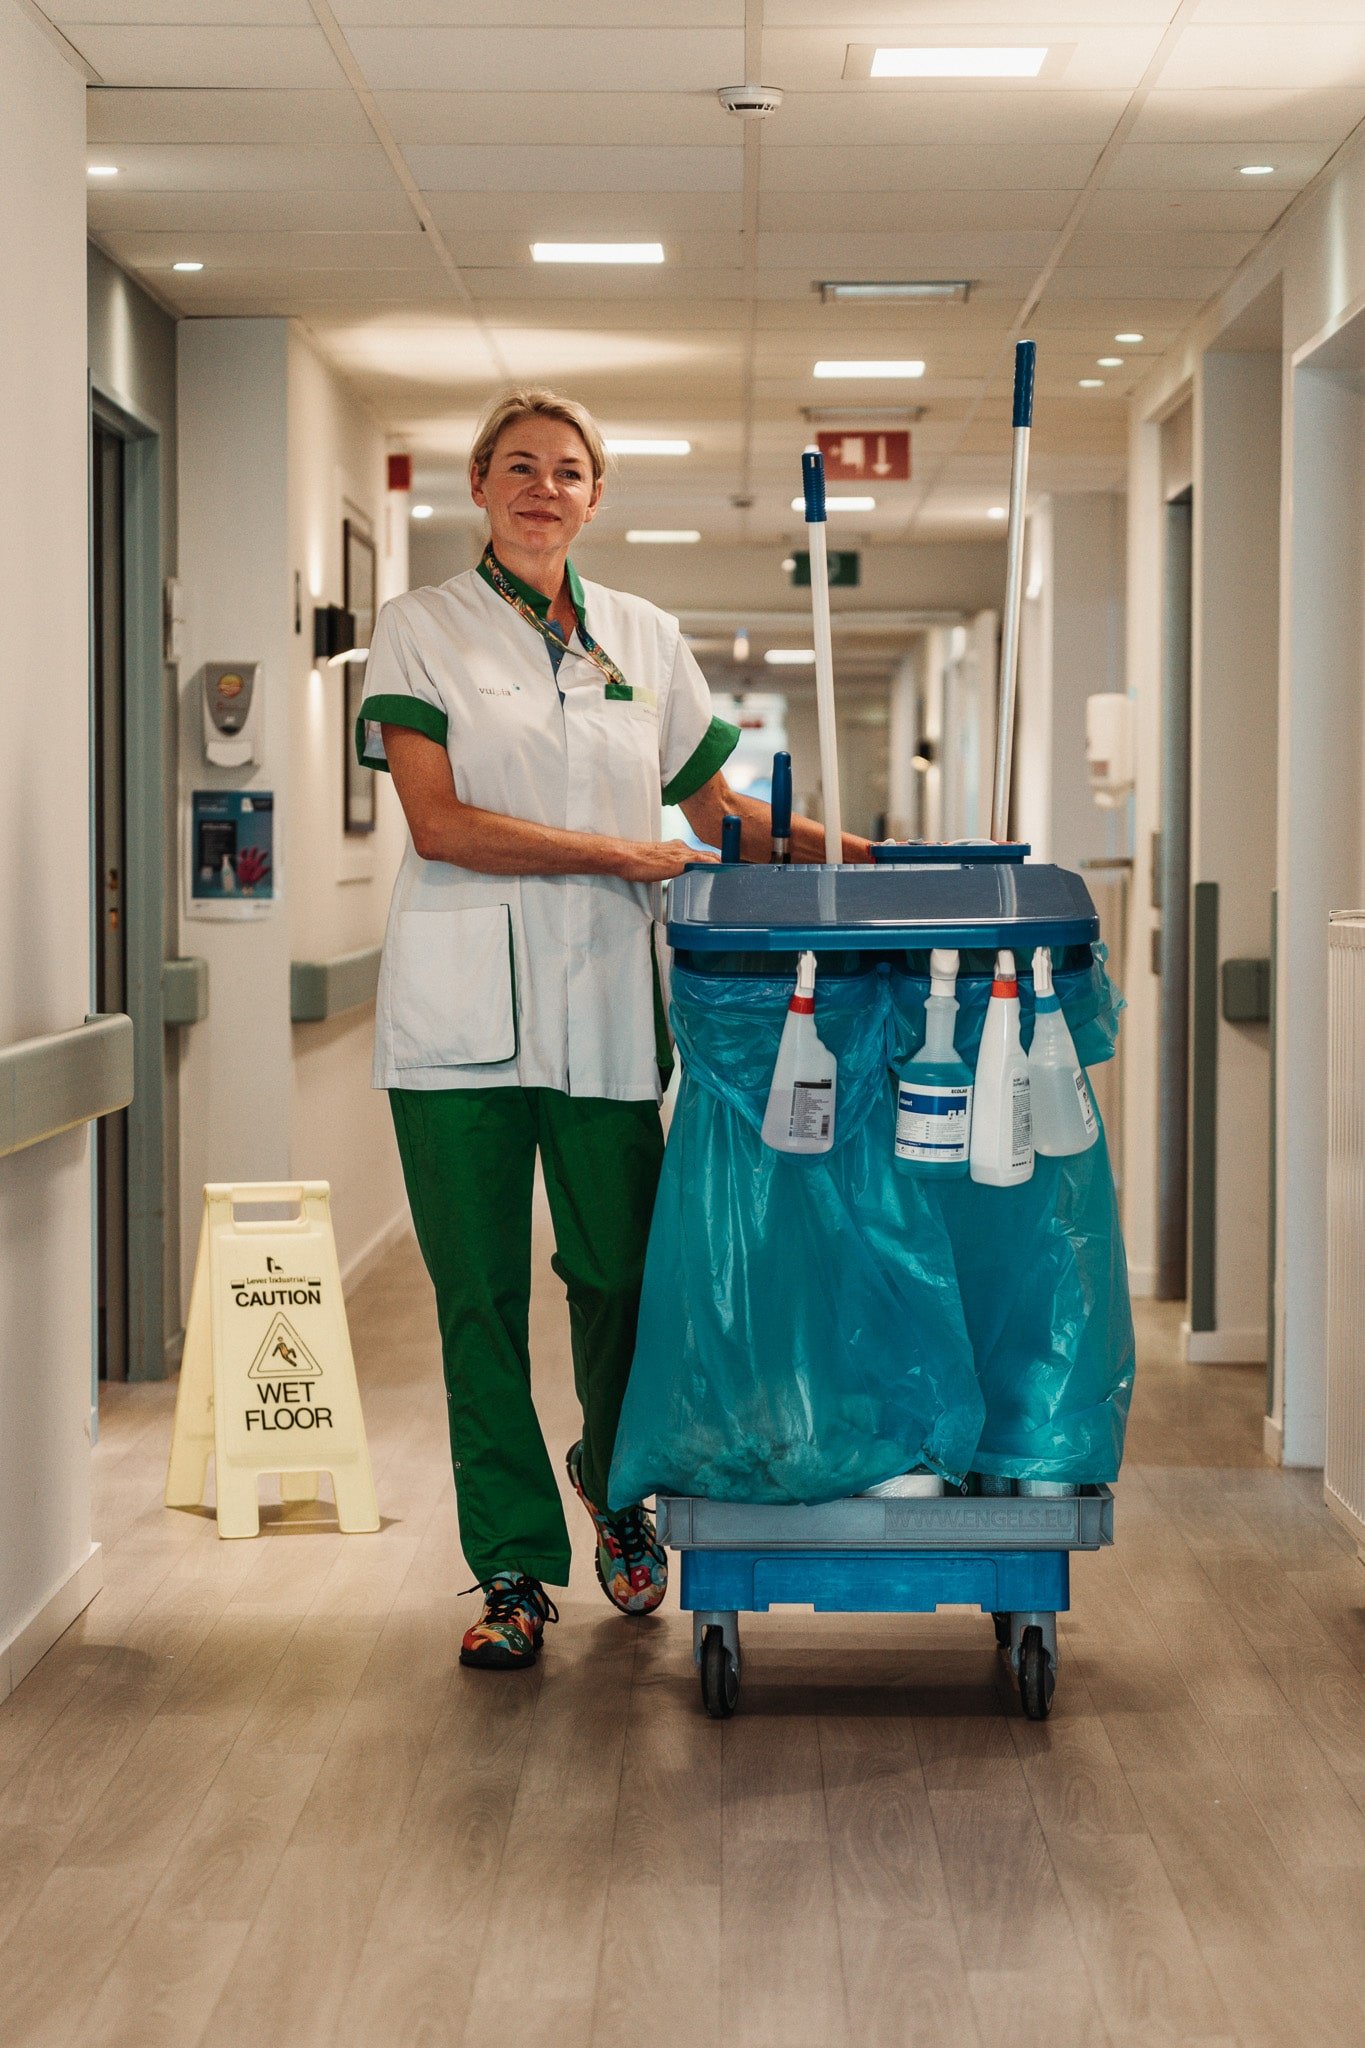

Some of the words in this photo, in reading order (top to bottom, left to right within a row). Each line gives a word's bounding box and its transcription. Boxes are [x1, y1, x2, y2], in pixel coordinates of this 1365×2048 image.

[246, 1277, 267, 1285] Lever
[235, 1289, 321, 1307] CAUTION
[257, 1382, 315, 1404] WET
[245, 1407, 333, 1431] FLOOR
[887, 1508, 1073, 1529] WWW.ENGELS.EU
